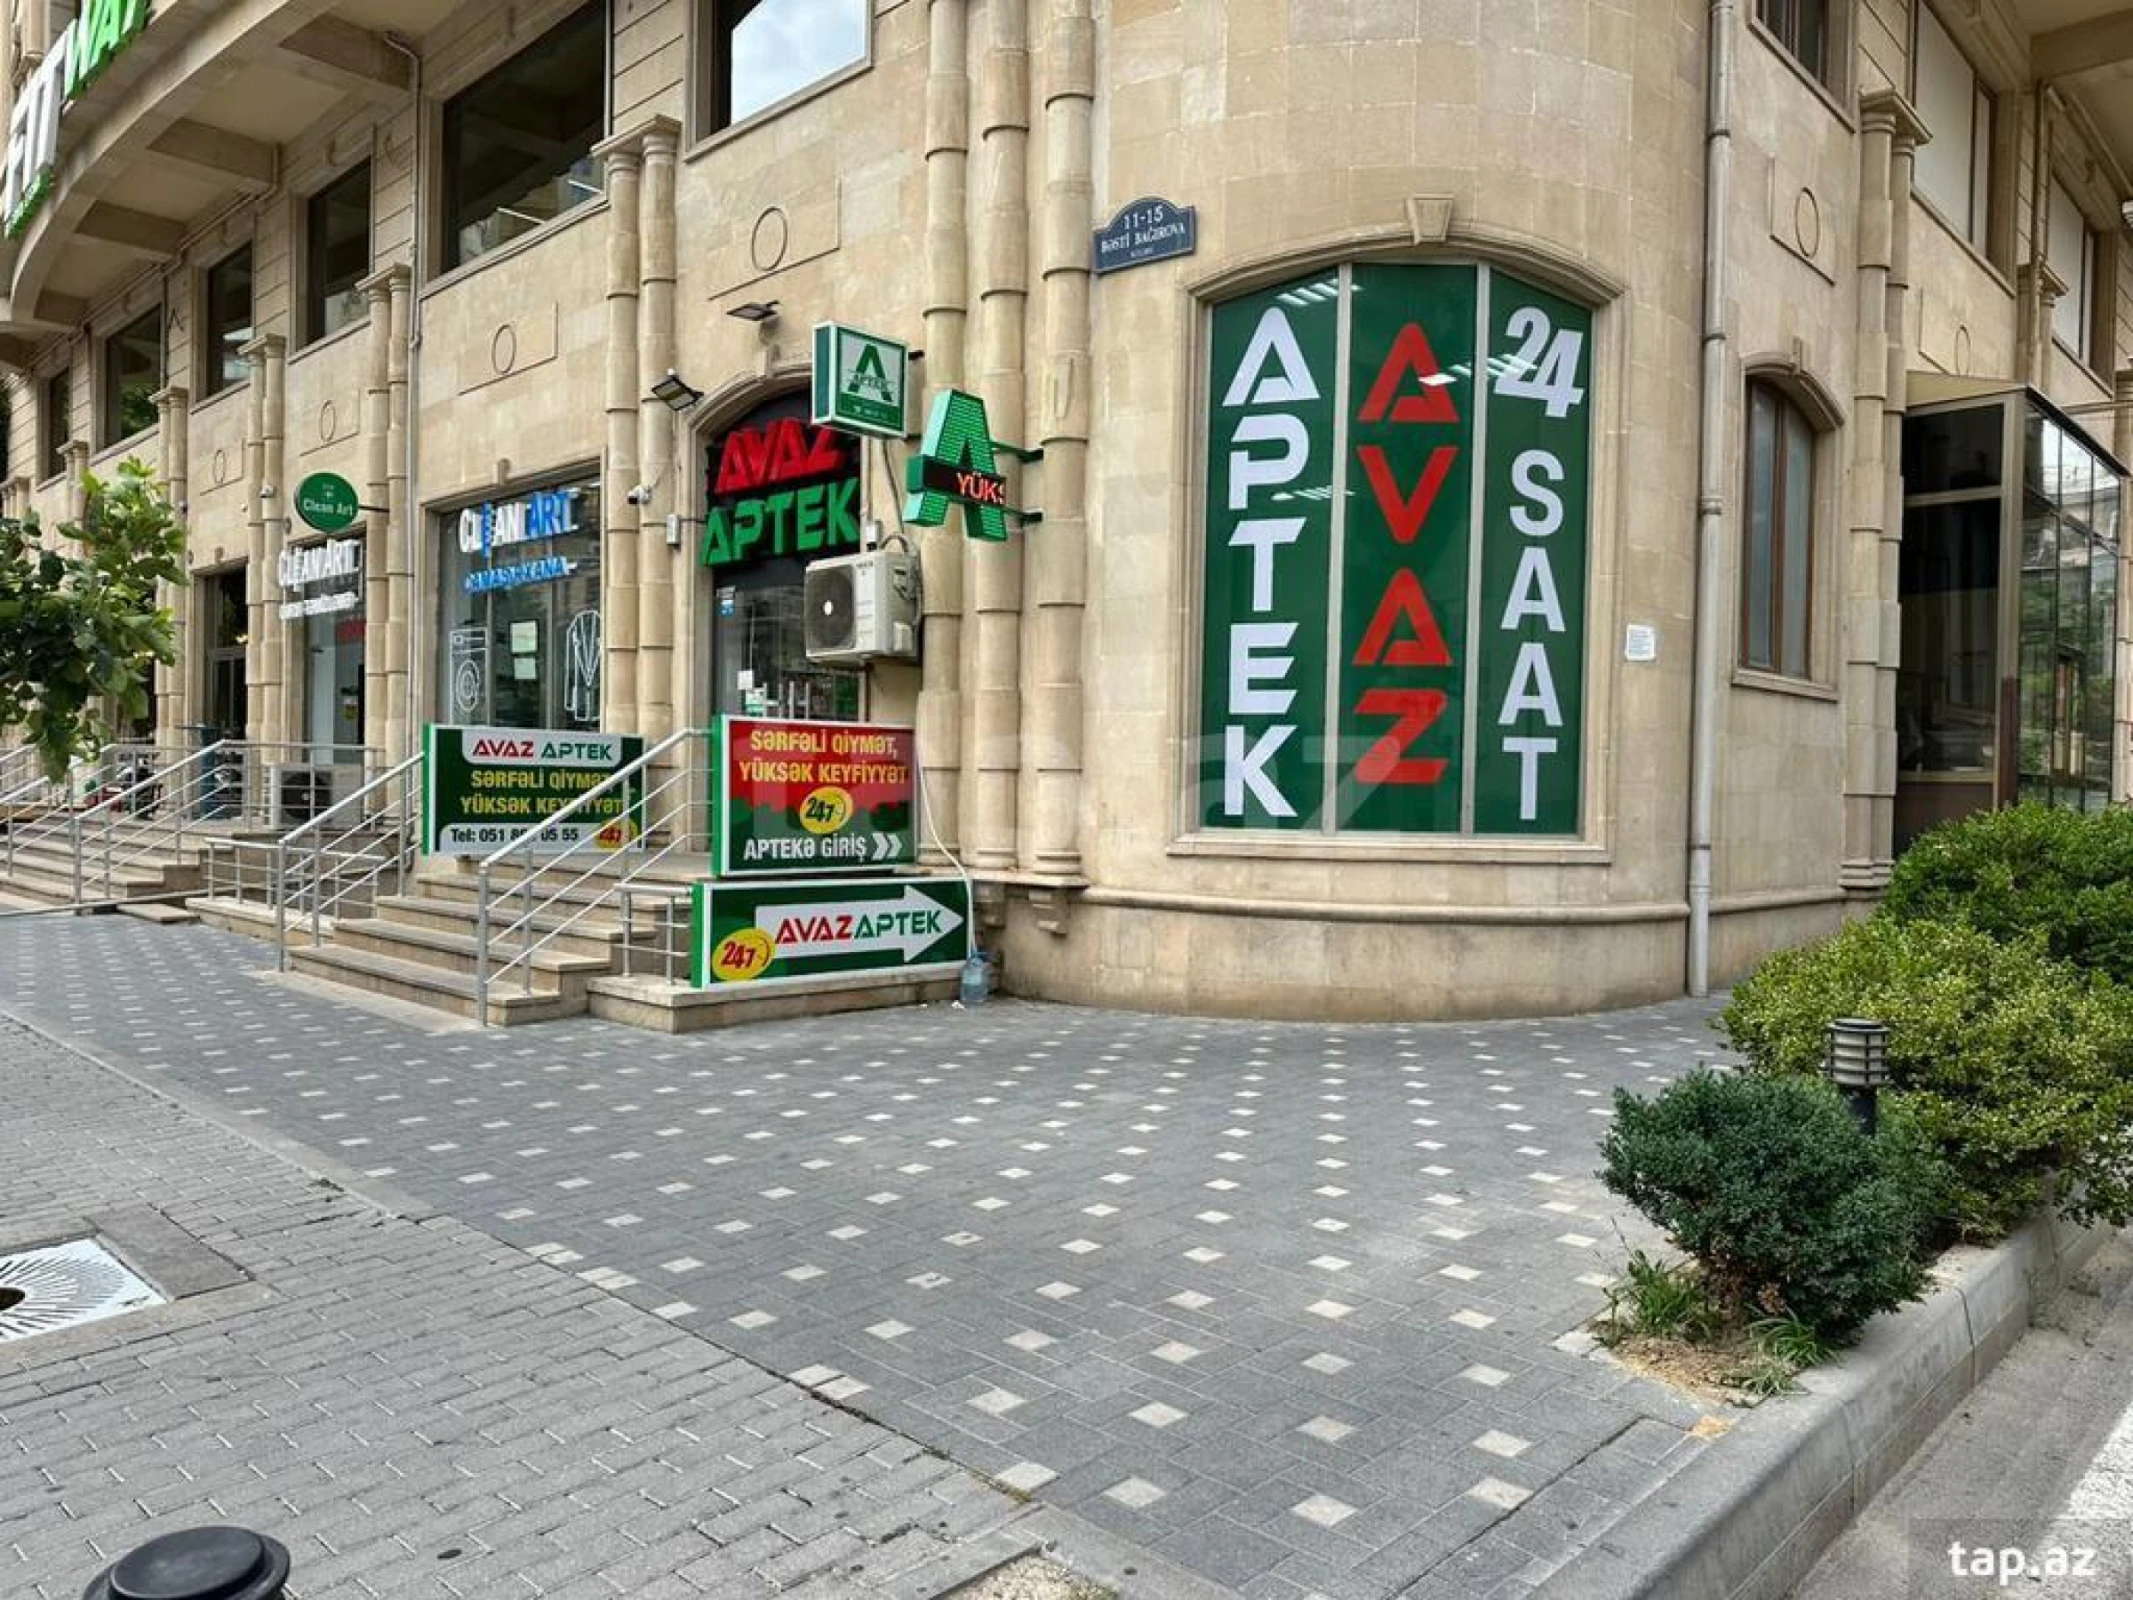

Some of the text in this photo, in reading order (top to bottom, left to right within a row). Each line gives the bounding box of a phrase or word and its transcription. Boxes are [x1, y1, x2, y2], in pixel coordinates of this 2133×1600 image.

[1124, 204, 1163, 230] 11-15
[715, 416, 842, 494] AVAZ
[303, 498, 334, 514] Clean
[699, 477, 861, 566] APTEK
[1223, 307, 1320, 817] APTEK
[1352, 323, 1460, 784] AVAZ
[1494, 307, 1584, 820] 24 SAAT
[472, 739, 612, 760] AVAZ APTEK
[751, 729, 826, 753] SƏRFƏLİ
[471, 768, 544, 788] SƏRFƏLİ
[739, 757, 907, 784] YÜKSƏK KEYFİYYƏT
[460, 793, 530, 814] YÜKSƏK
[451, 828, 476, 842] Tel:
[479, 829, 505, 842] 051
[562, 828, 579, 841] 55
[743, 833, 867, 863] APTEKƏ GİRİŞ
